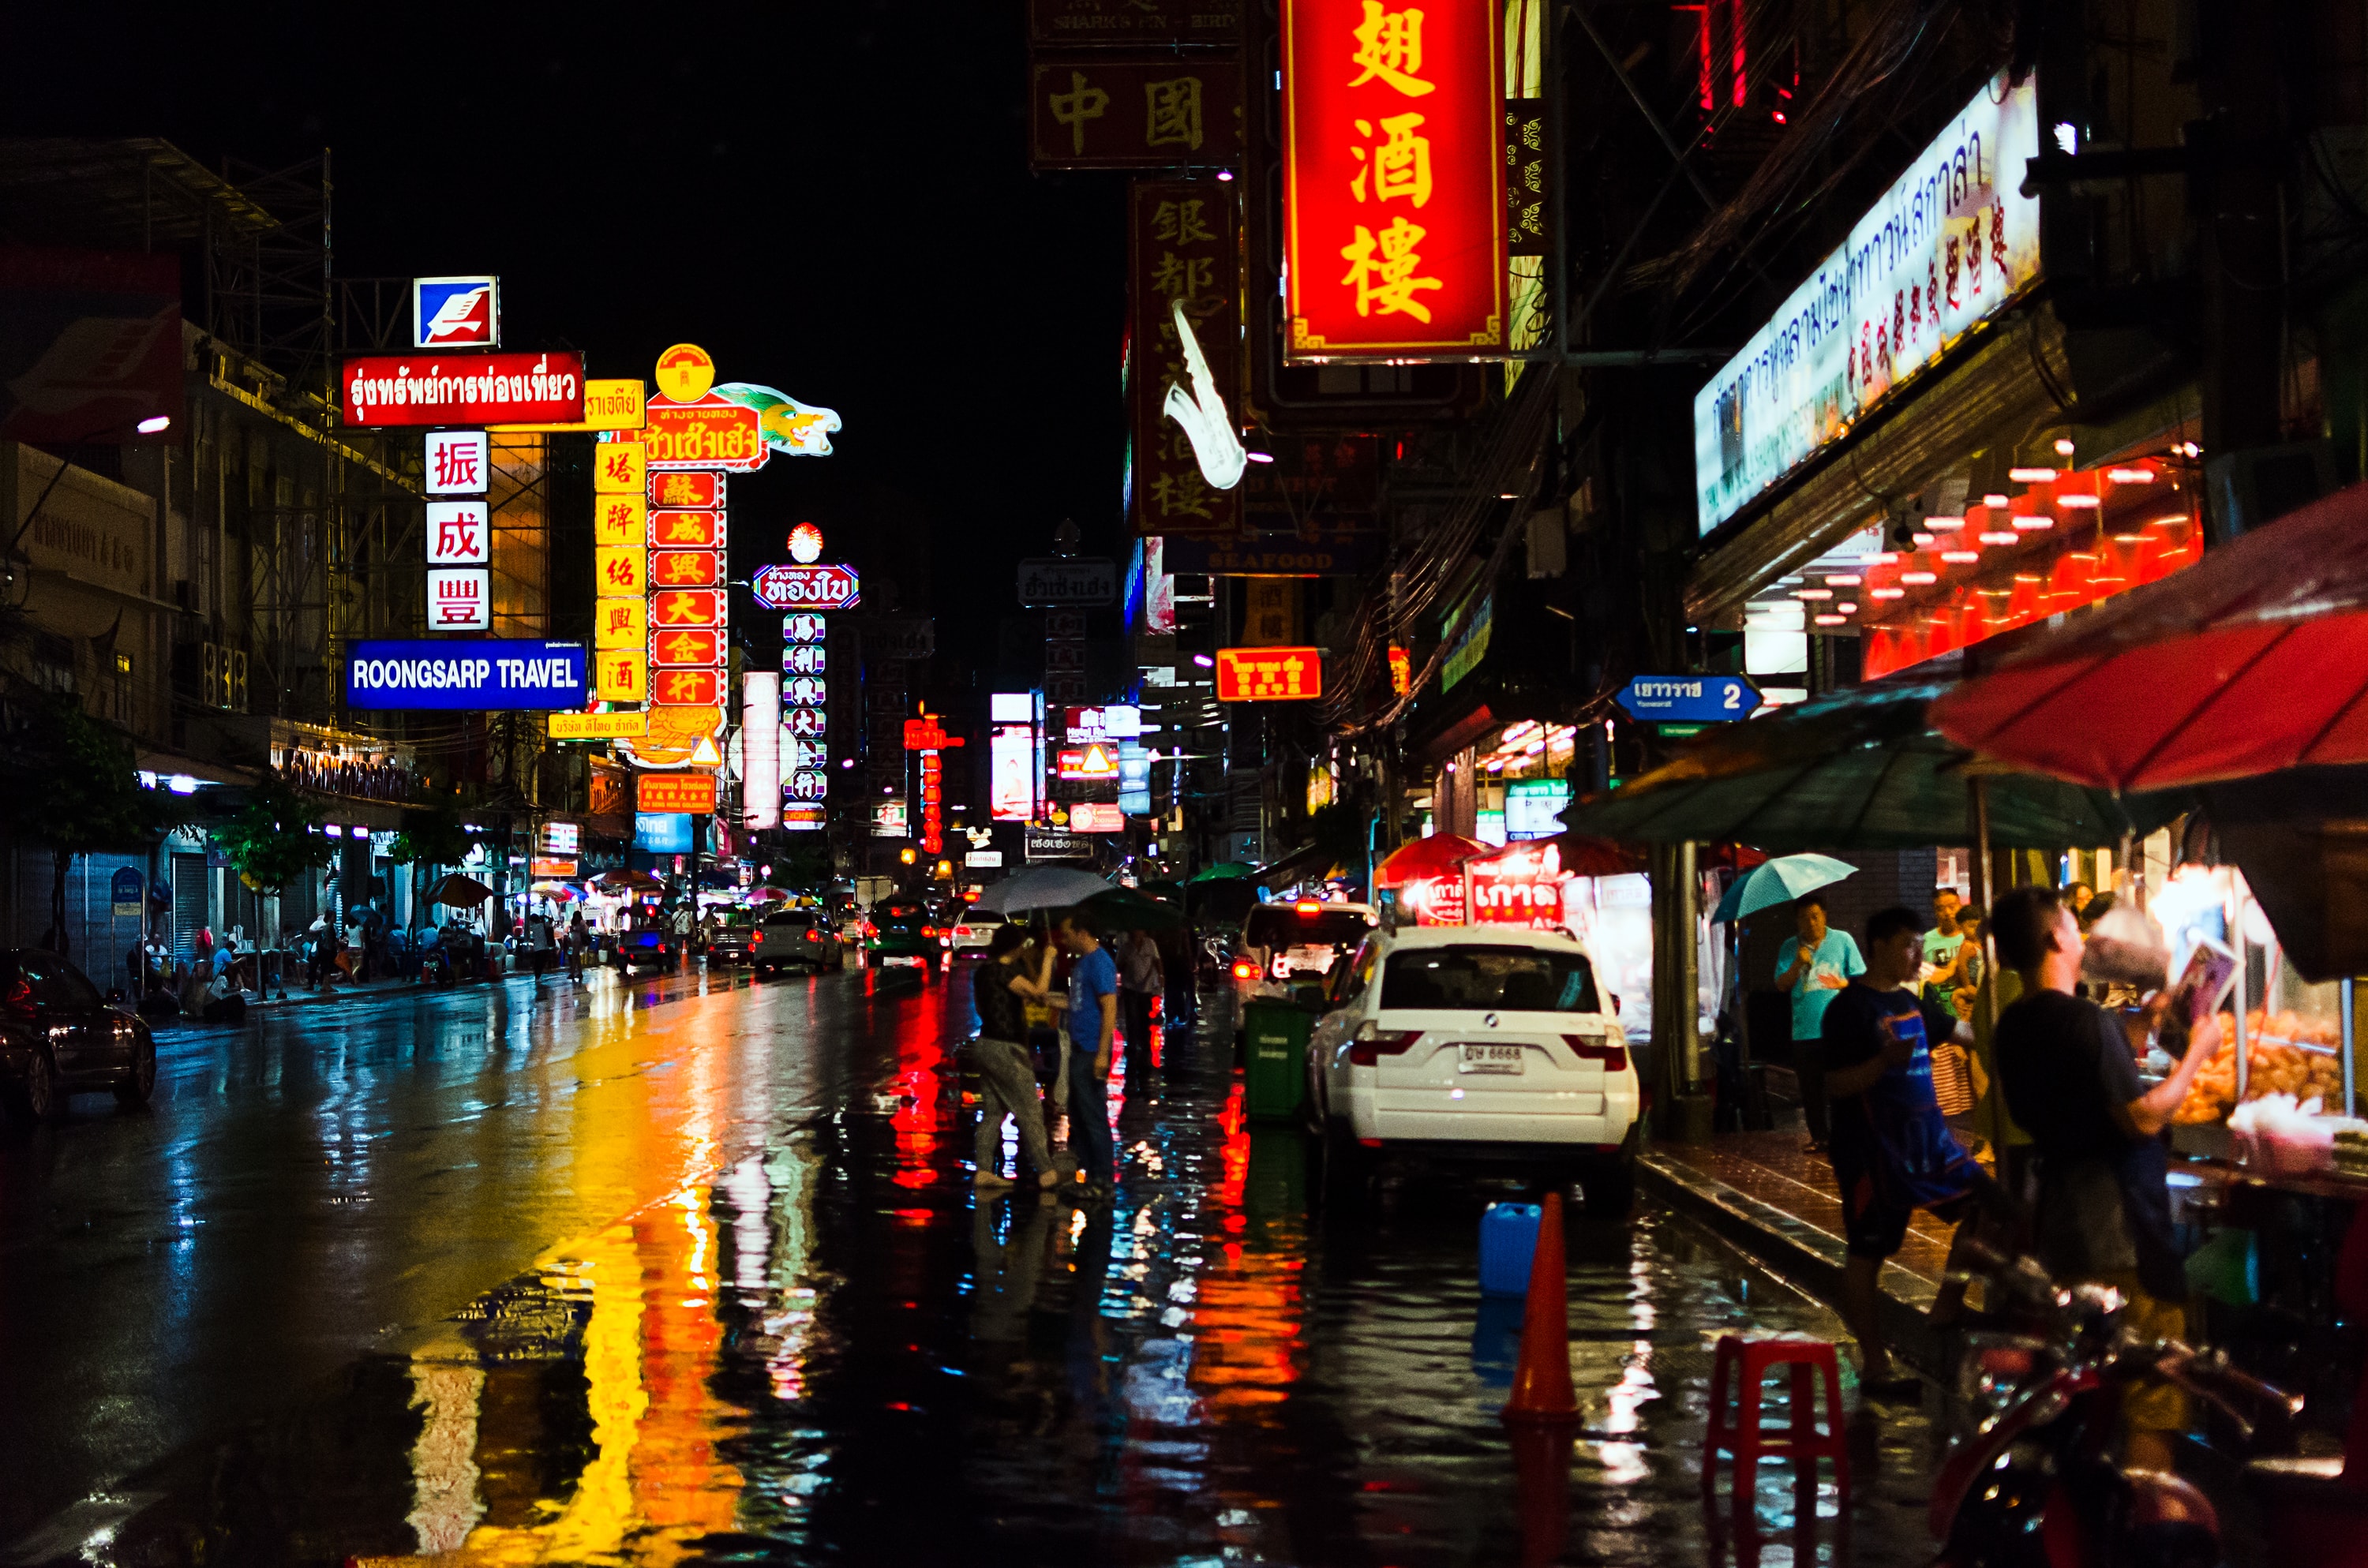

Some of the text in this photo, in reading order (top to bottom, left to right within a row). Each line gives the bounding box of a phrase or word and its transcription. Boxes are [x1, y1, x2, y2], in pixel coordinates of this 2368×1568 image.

[1048, 70, 1243, 156] 中國
[350, 354, 575, 421] รุ่งทรัพย์การท่องเที่ยว
[1150, 199, 1223, 520] 銀都酒樓
[435, 443, 480, 625] 振成豐
[663, 474, 708, 702] 蘇成興大金行
[766, 571, 849, 602] ทองใบ
[354, 659, 579, 688] ROONGSARP TRAVEL
[1634, 682, 1702, 698] เยาวราช
[1723, 684, 1741, 709] 2
